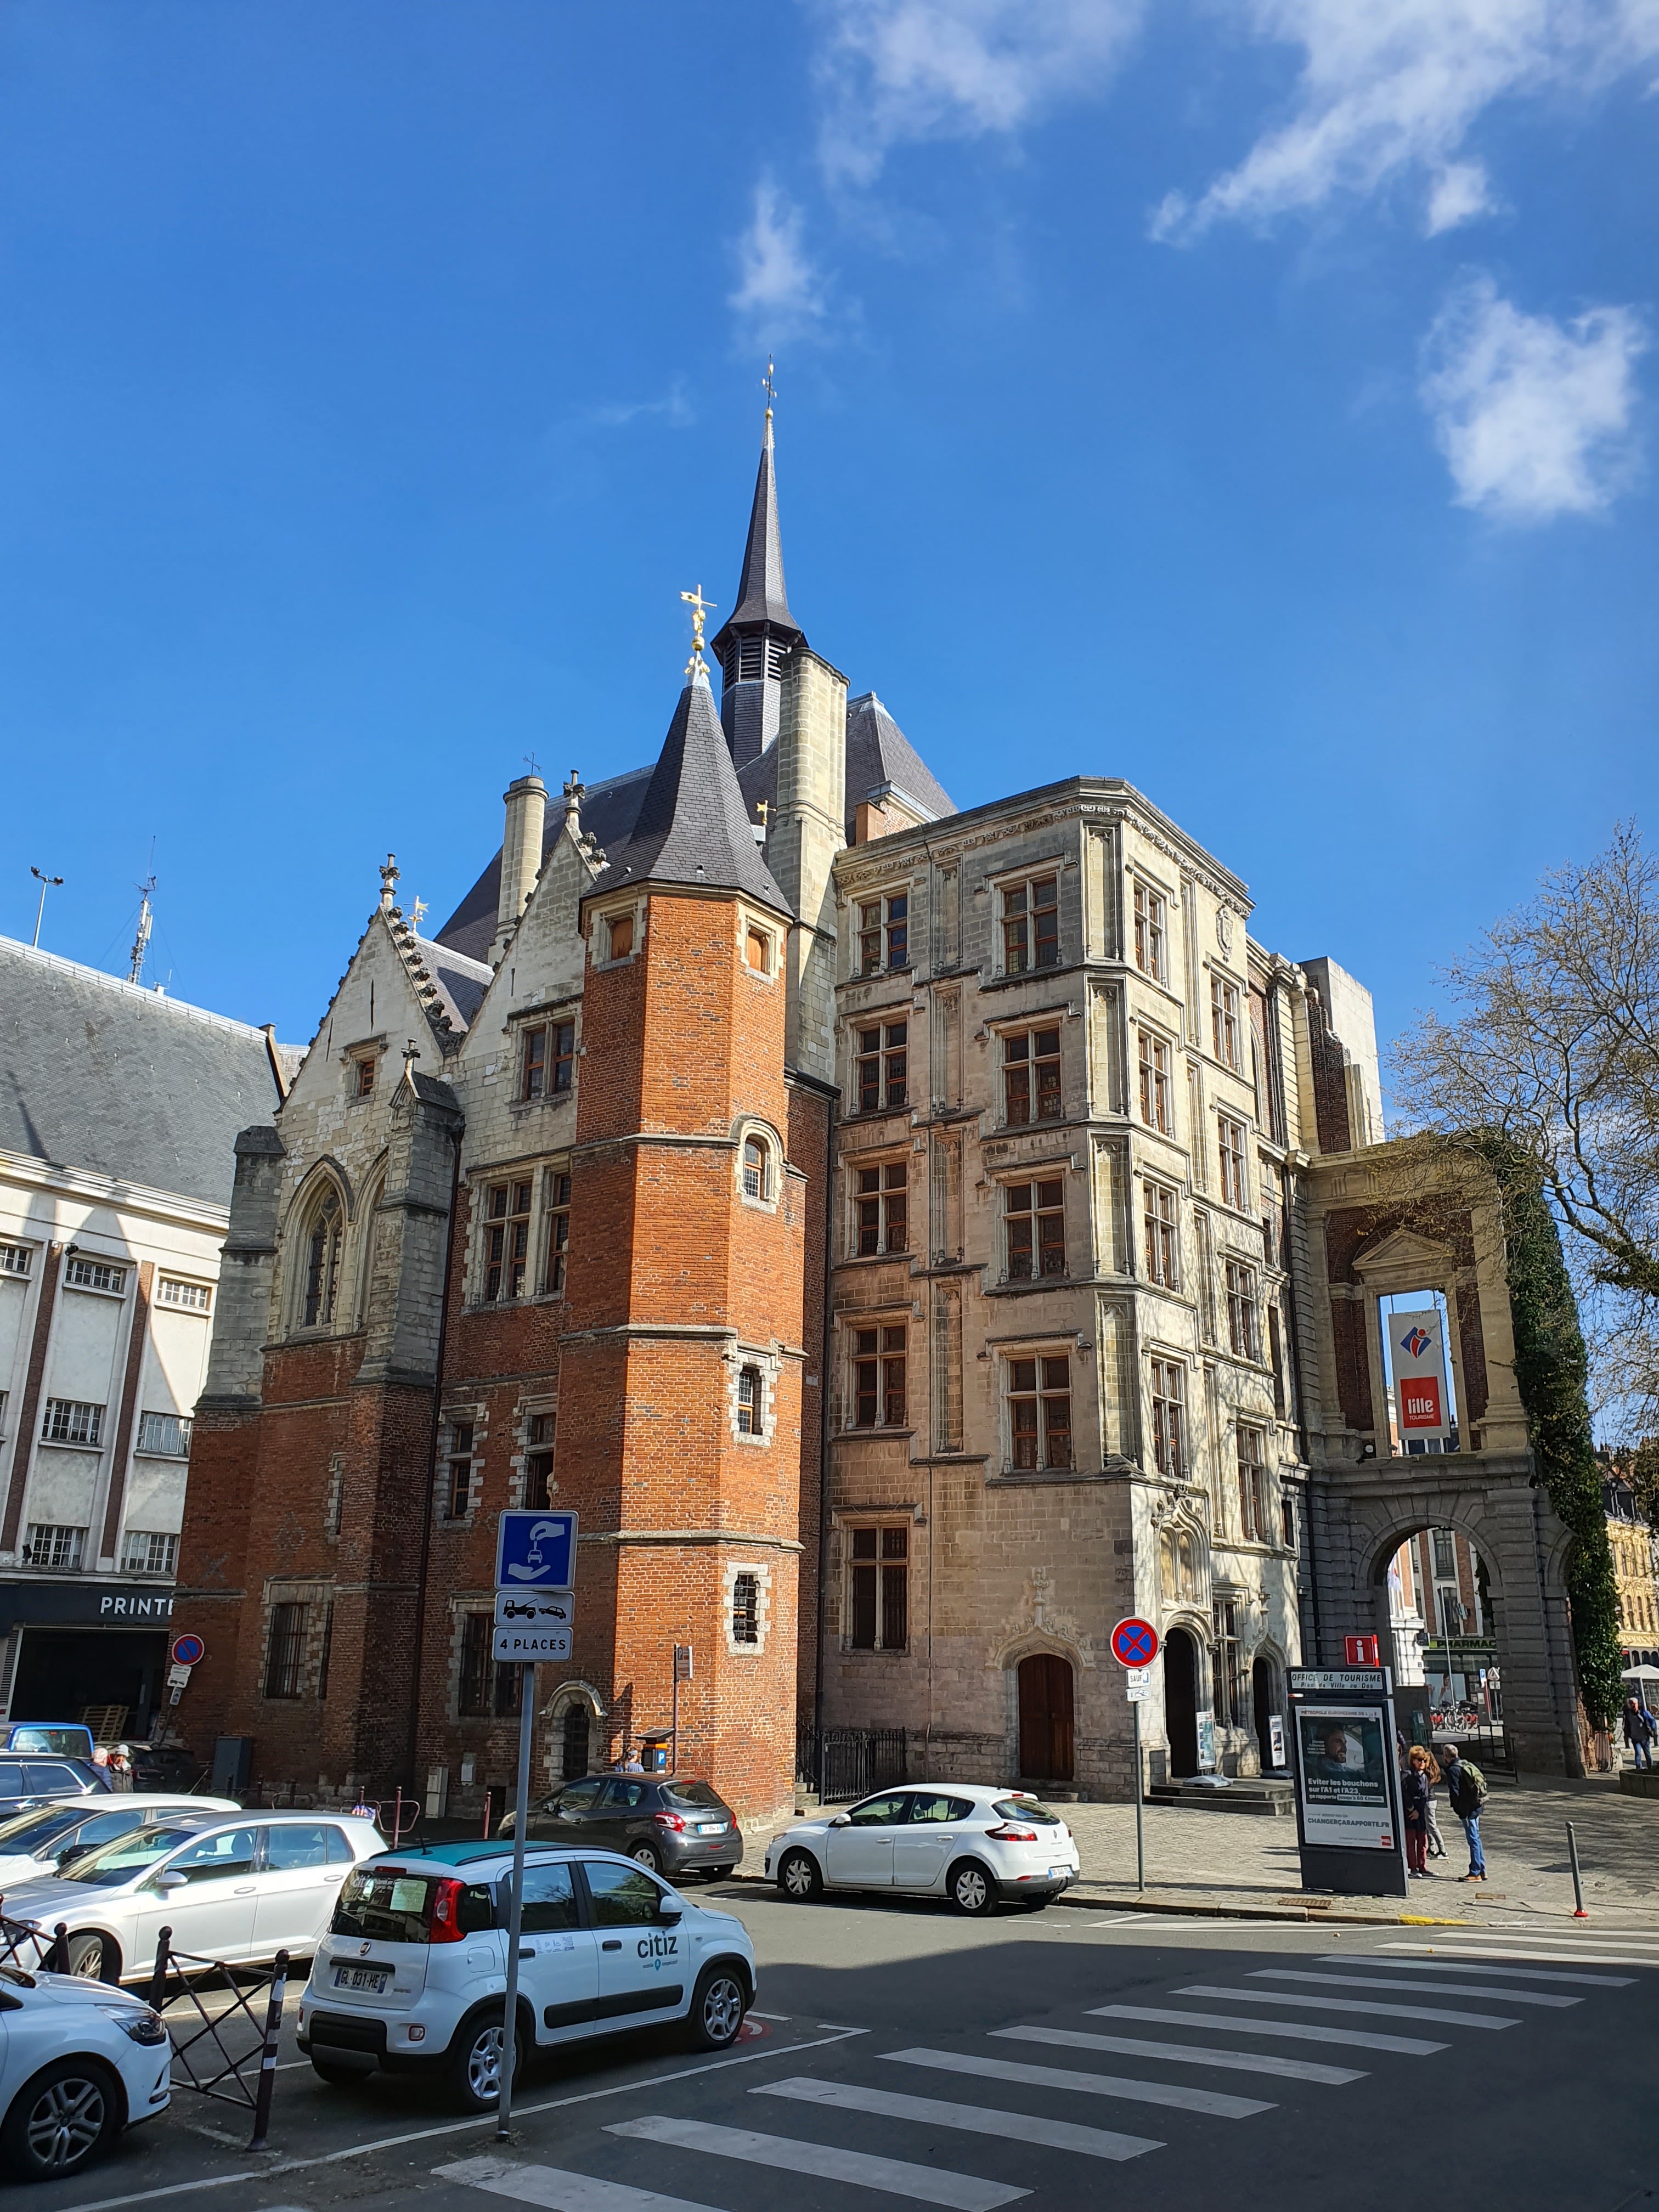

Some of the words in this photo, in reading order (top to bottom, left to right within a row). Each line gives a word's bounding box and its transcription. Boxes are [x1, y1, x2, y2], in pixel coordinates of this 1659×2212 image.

[1408, 1398, 1434, 1414] lille
[500, 1639, 508, 1650] 4
[514, 1639, 566, 1650] PLACES
[658, 1753, 664, 1763] P
[1342, 1779, 1379, 1787] bouchons
[1307, 1818, 1390, 1828] CHANGERÇARAPPORTE.FR
[637, 1931, 678, 1959] citiz
